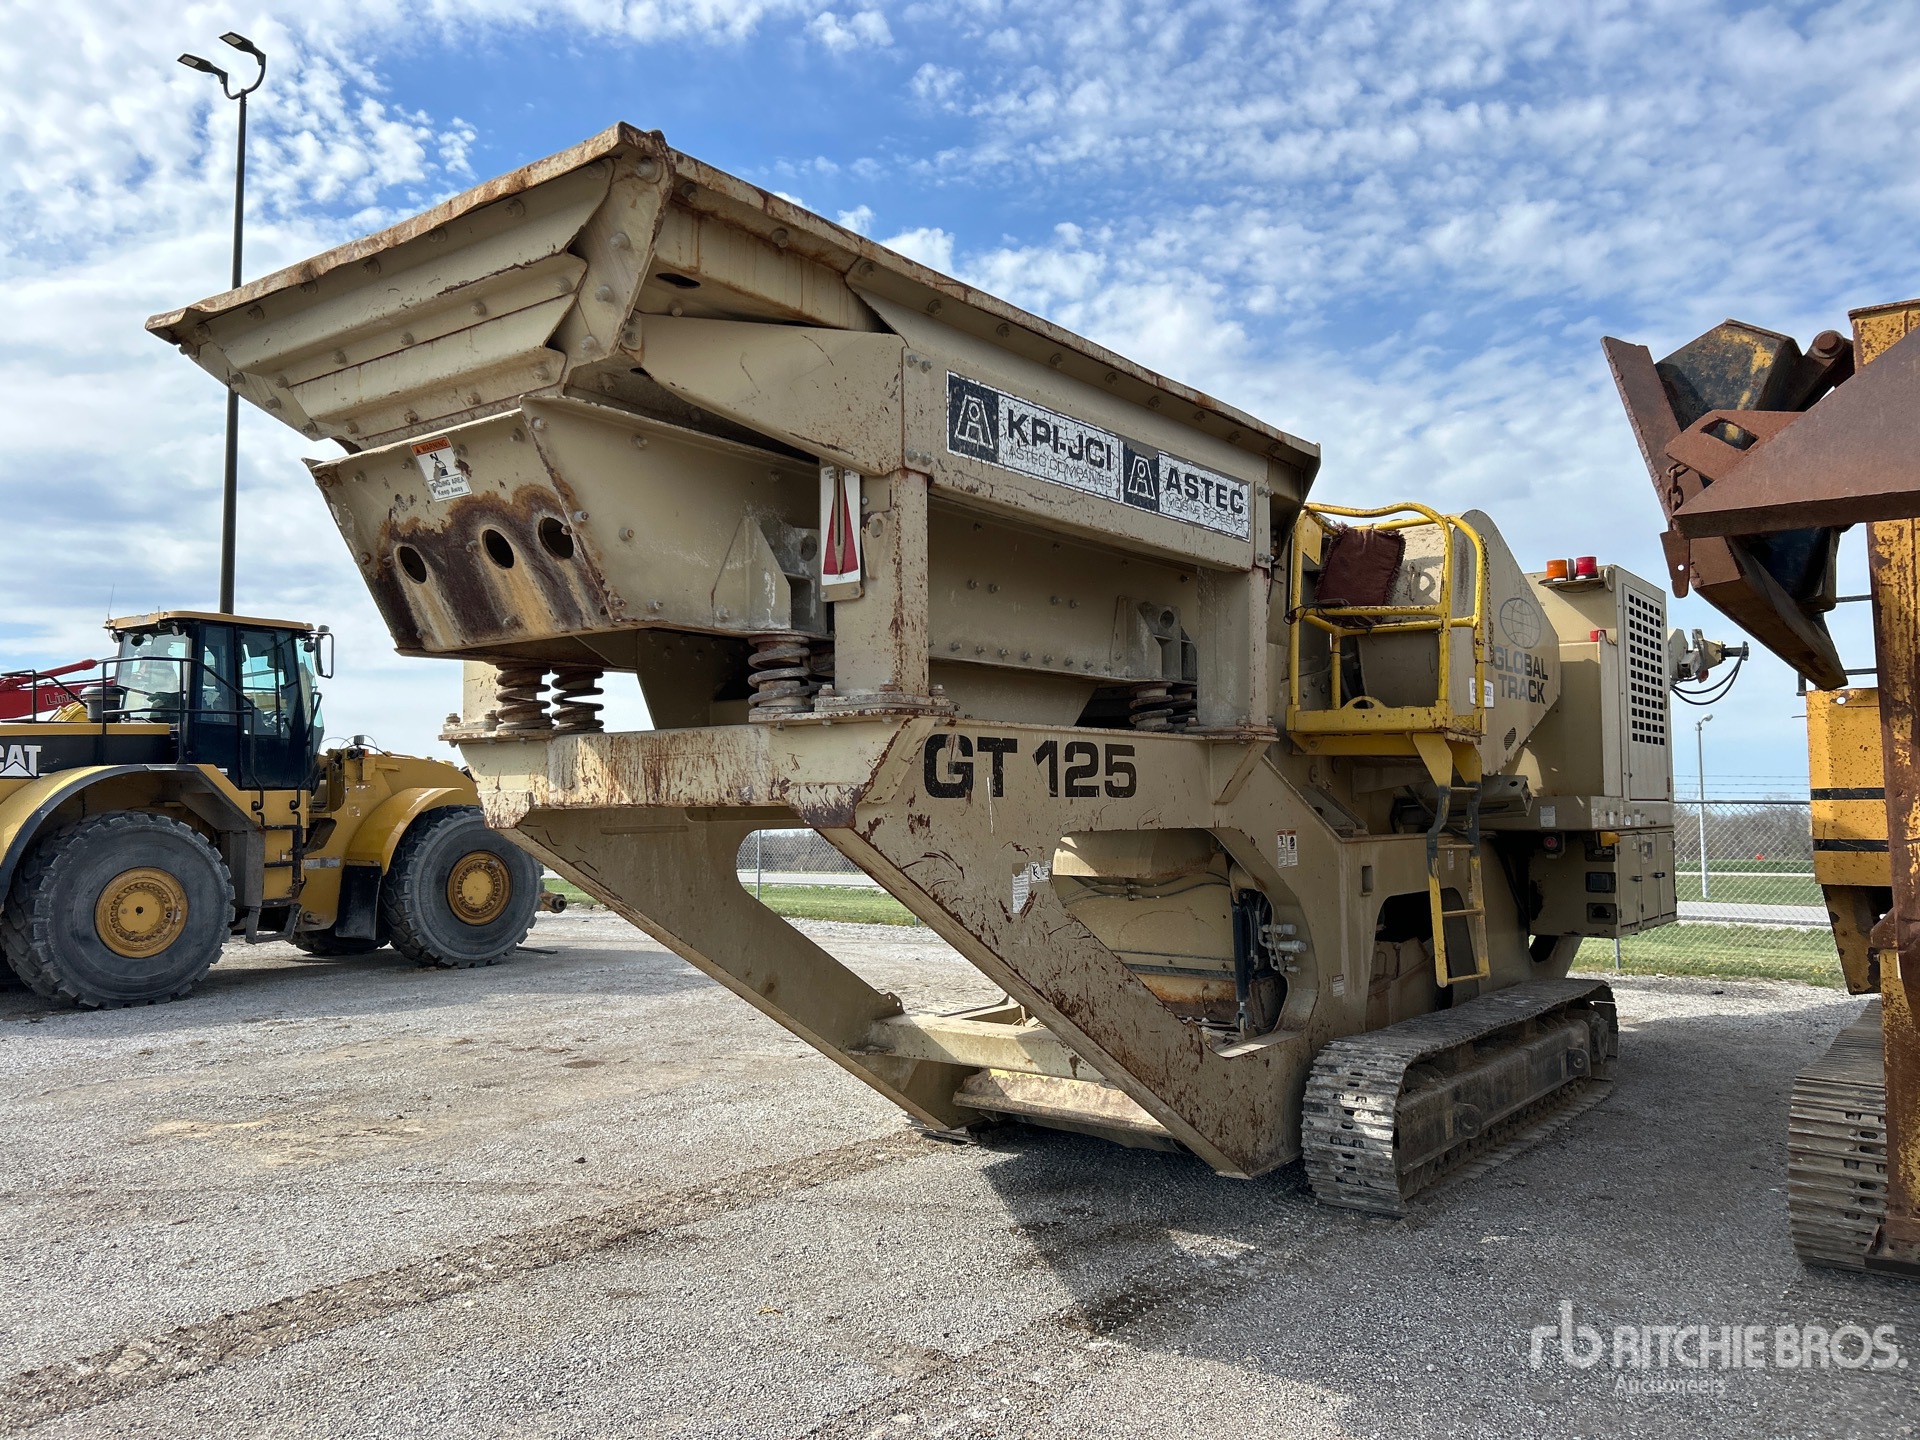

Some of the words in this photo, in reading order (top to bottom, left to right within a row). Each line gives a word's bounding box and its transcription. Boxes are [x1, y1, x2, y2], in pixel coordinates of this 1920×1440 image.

[421, 439, 447, 451] WARNING
[1007, 408, 1111, 472] KPI-JCI
[1166, 467, 1243, 514] ASTEC
[1493, 646, 1548, 680] GLOBAL
[1498, 674, 1545, 704] TRACK
[0, 744, 42, 777] AT
[924, 734, 1018, 798] GT
[1032, 740, 1137, 798] 125
